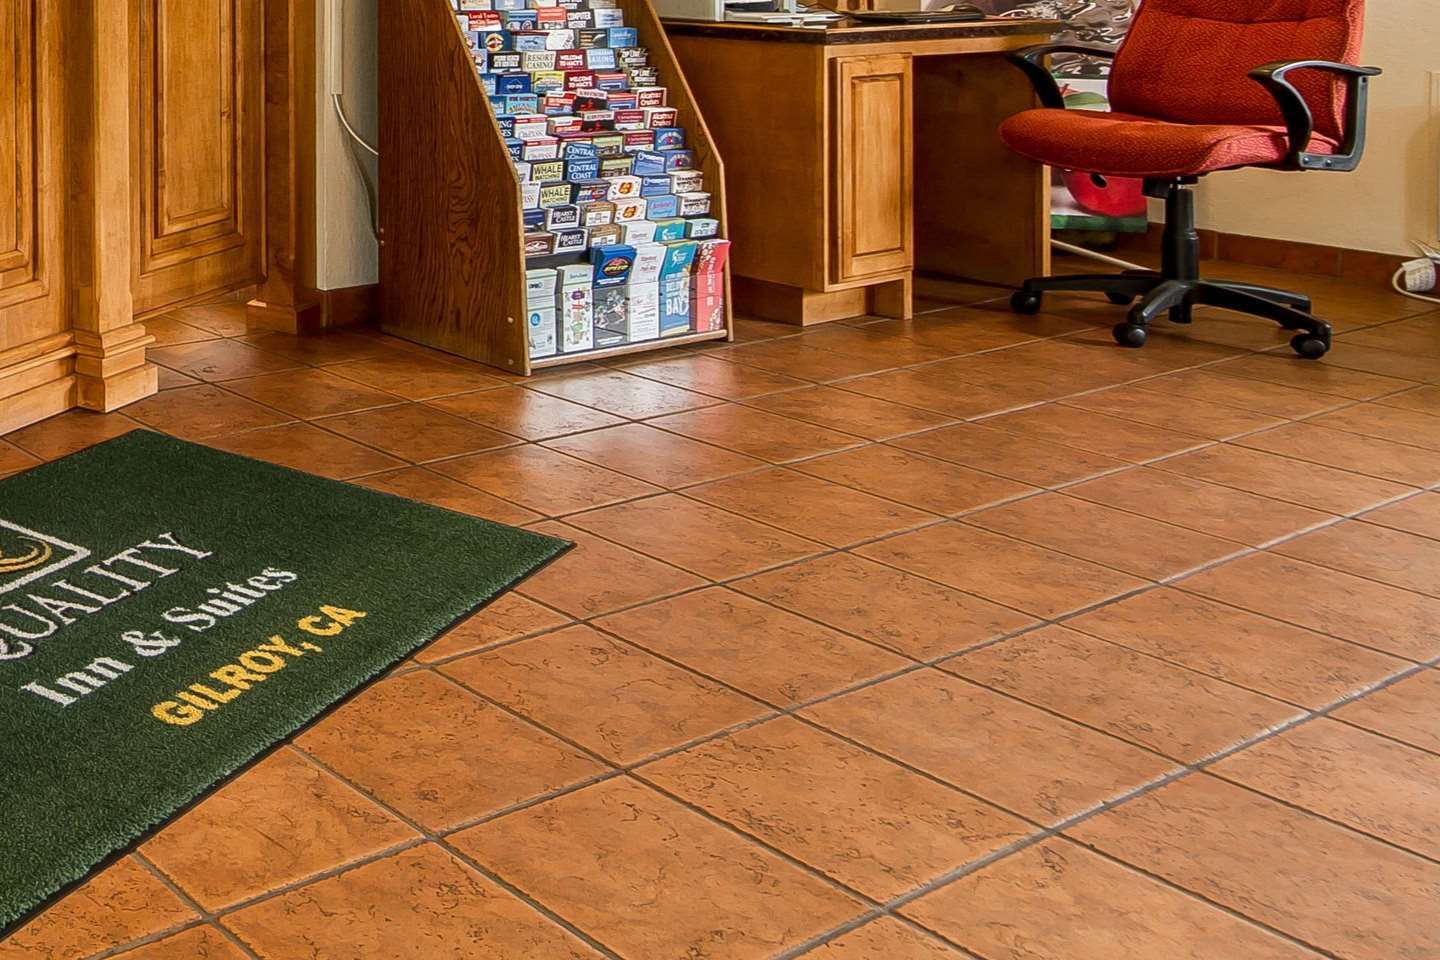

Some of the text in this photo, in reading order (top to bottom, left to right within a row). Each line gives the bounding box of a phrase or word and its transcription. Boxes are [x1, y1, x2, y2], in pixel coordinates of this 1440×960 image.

[527, 53, 554, 61] RESORT
[527, 61, 553, 70] CASINO
[567, 146, 595, 157] CENTRAL
[534, 164, 561, 175] WHALE
[568, 164, 597, 173] CENTRAL
[571, 171, 592, 180] COAST
[541, 186, 569, 197] WHALE
[553, 210, 574, 218] HEARST
[556, 215, 576, 224] CASTLE
[560, 234, 581, 242] HEARST
[562, 238, 583, 246] CASTLE
[21, 566, 299, 707] Inn & Suites
[151, 604, 368, 728] GILROY, CA
